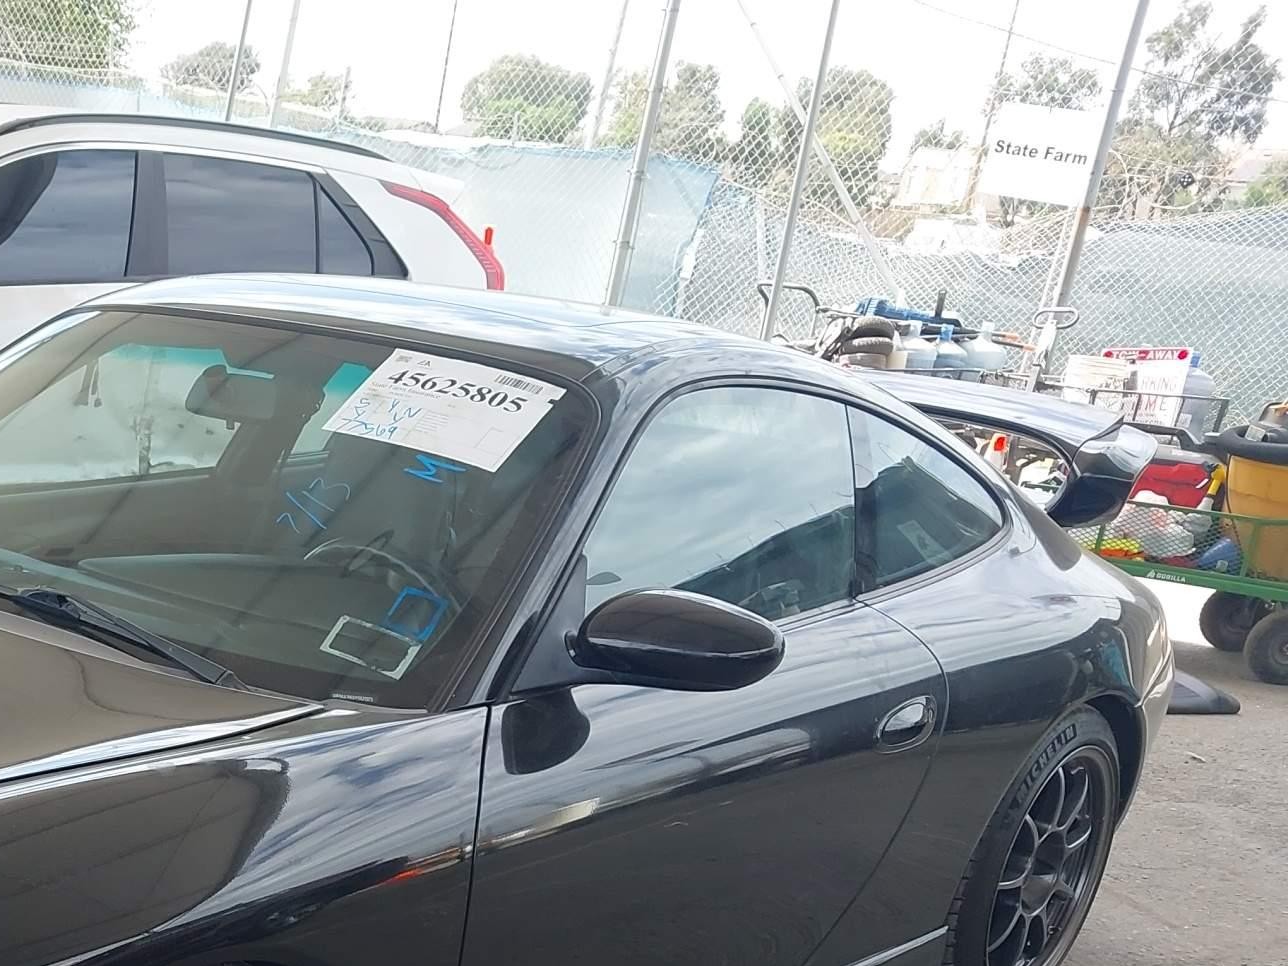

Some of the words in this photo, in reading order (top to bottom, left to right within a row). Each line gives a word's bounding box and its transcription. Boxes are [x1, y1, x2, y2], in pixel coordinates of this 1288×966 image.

[994, 139, 1039, 158] State
[1043, 146, 1088, 165] Farm
[387, 369, 529, 413] 45625805
[1156, 572, 1186, 583] GORILLA
